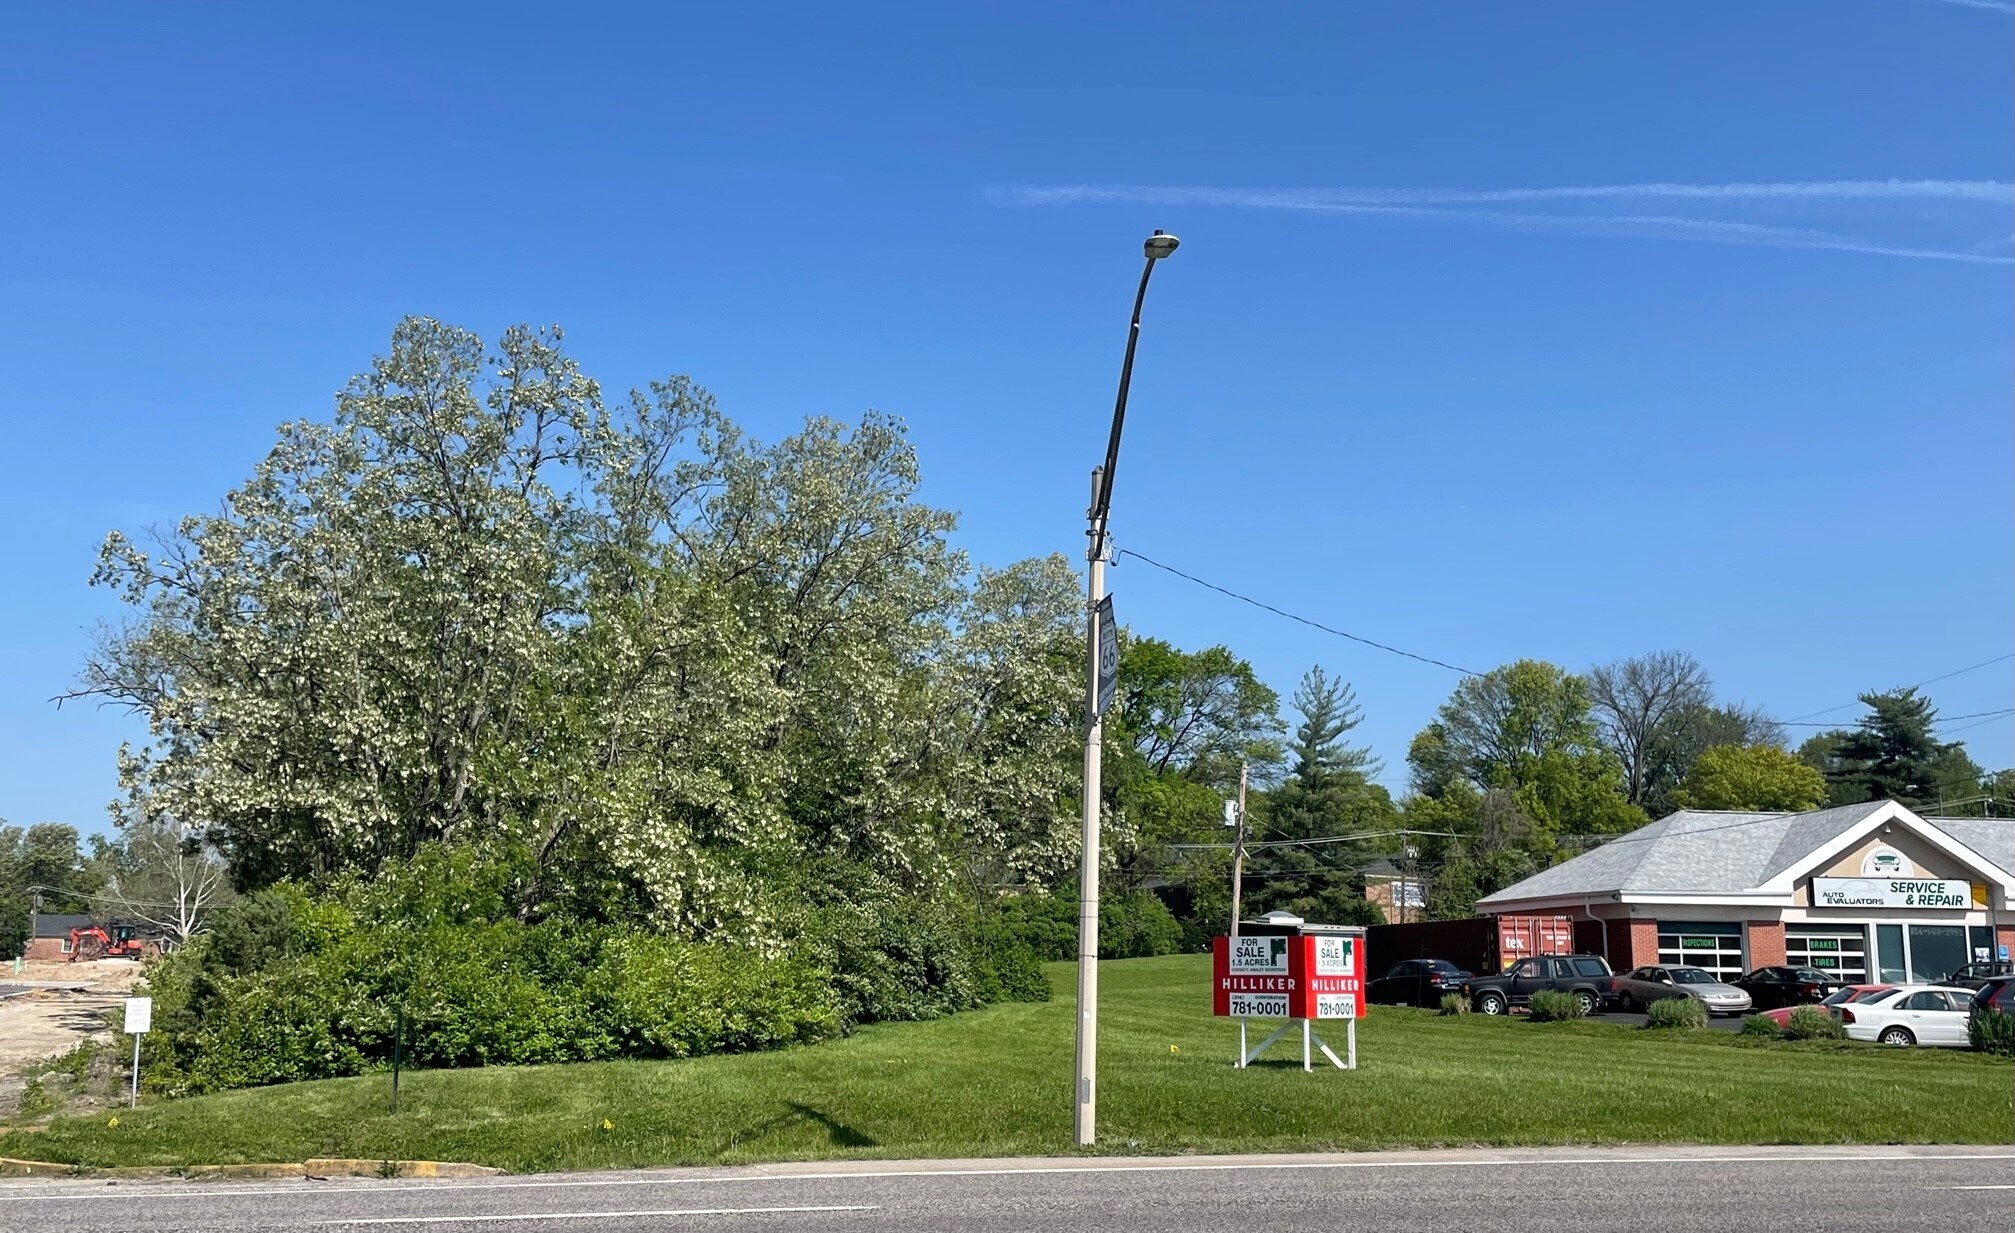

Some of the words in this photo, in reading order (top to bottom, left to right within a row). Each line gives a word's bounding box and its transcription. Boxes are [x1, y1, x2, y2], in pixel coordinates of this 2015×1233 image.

[1103, 643, 1115, 669] 66
[1890, 882, 1945, 894] SERVICE
[1905, 894, 1915, 905] &
[1918, 894, 1964, 906] REPAIR
[1241, 938, 1258, 947] FOR
[1324, 939, 1335, 947] FOR
[1505, 936, 1525, 949] tex
[1682, 938, 1715, 948] INSPECTIONS
[1810, 940, 1838, 950] BRAKES
[1236, 947, 1265, 958] SALE
[1320, 948, 1340, 959] SALE
[1231, 959, 1243, 967] 1.5
[1244, 959, 1270, 967] ACRES
[1814, 958, 1835, 967] TIRES
[1222, 978, 1296, 990] HILLIKER
[1311, 979, 1360, 991] HILLIKER
[1232, 1001, 1287, 1016] 781-0001
[1319, 1002, 1354, 1016] 781-0001
